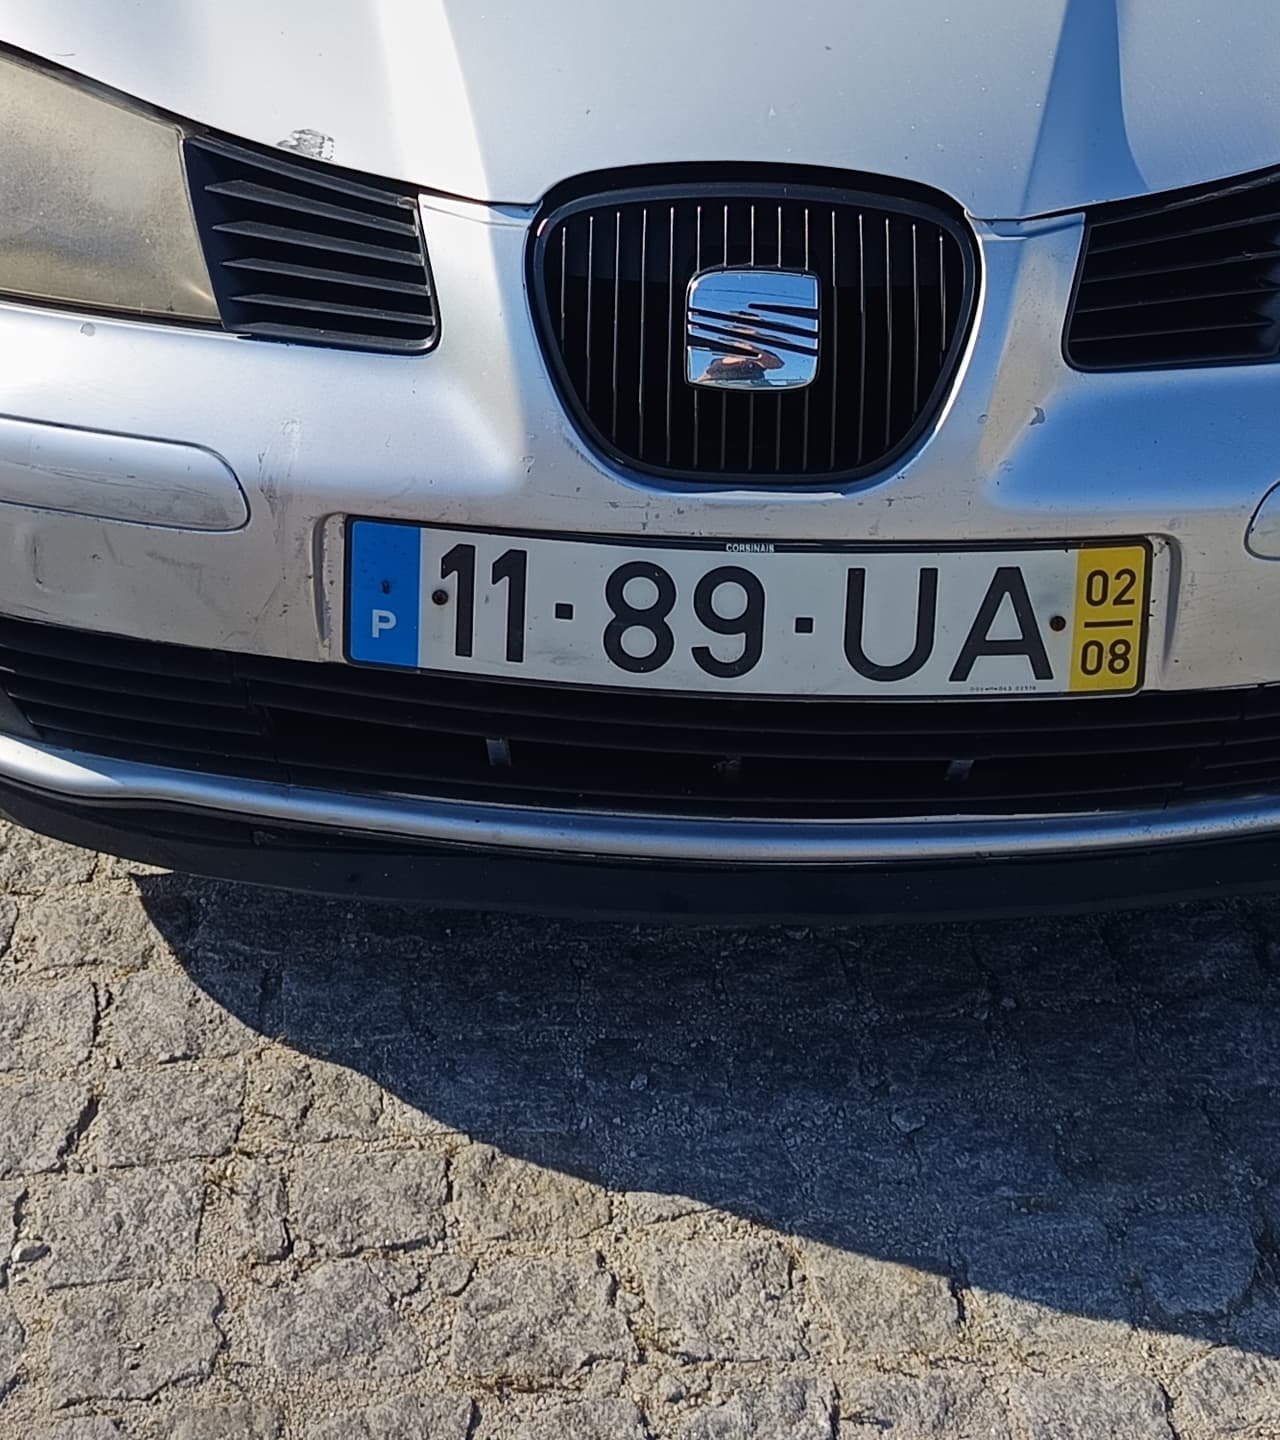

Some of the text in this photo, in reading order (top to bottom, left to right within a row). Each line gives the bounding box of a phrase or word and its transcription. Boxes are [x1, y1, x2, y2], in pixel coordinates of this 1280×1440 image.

[1085, 568, 1138, 607] 02
[371, 609, 397, 638] P
[1080, 638, 1132, 676] 08
